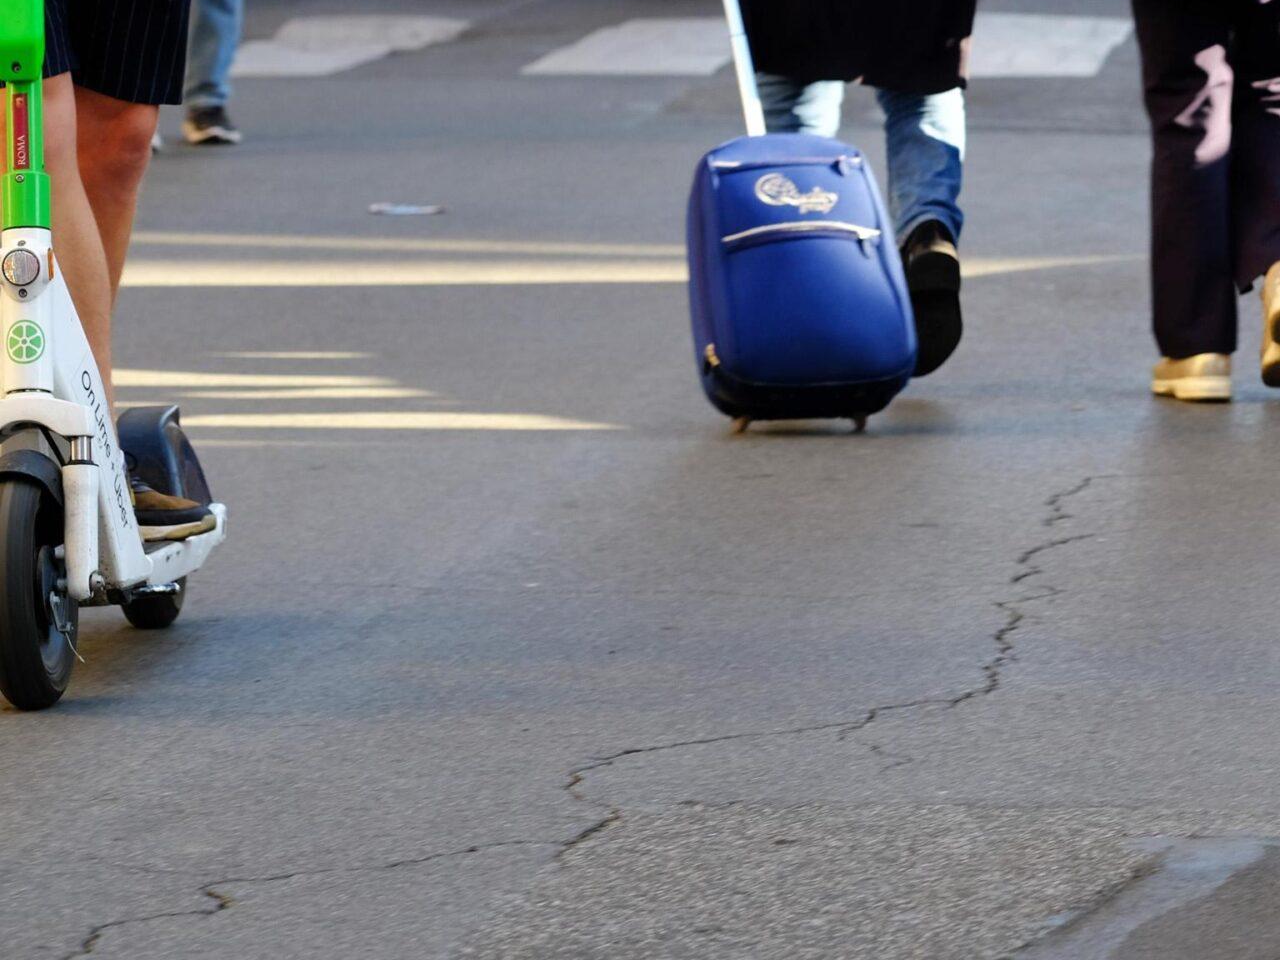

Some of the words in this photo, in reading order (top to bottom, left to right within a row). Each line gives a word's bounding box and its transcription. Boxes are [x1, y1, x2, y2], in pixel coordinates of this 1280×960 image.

[16, 134, 26, 166] ROMA
[81, 370, 96, 405] On
[94, 403, 112, 459] Lime
[113, 473, 129, 529] Uber
